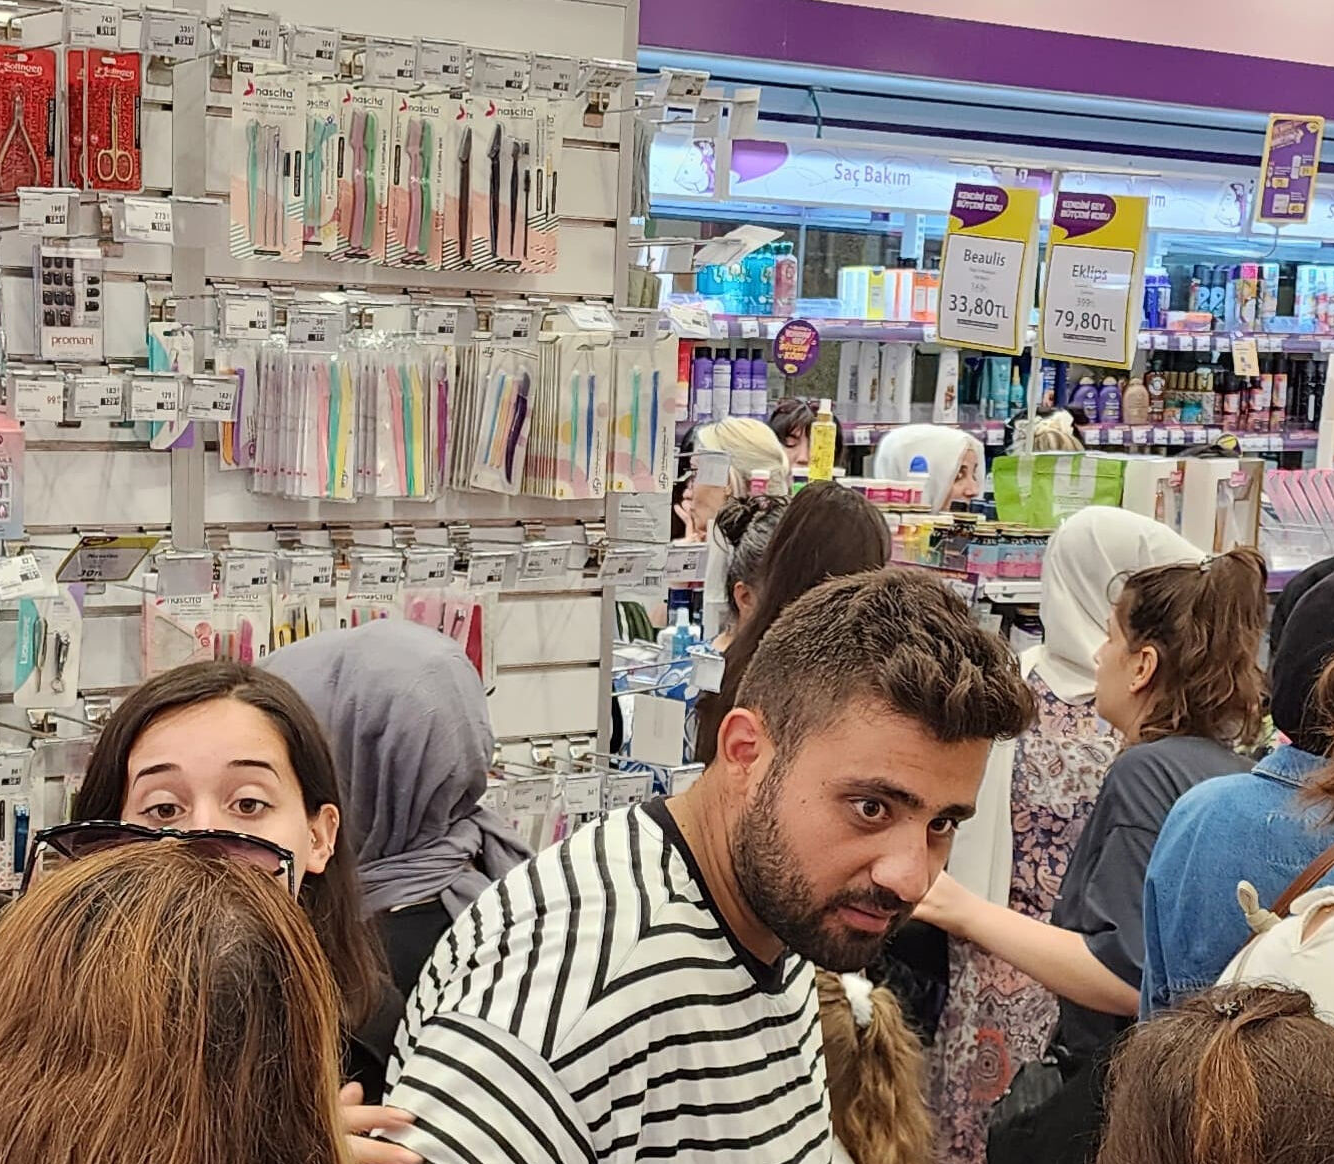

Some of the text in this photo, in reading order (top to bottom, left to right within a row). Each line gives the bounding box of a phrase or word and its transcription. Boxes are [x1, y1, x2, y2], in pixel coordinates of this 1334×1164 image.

[255, 86, 294, 99] nascita
[351, 95, 384, 106] nascita
[407, 103, 440, 114] nascita
[497, 106, 536, 117] nascita
[834, 163, 911, 188] Saç Bakım
[964, 249, 1006, 266] Beaulis
[1072, 264, 1108, 282] Eklips
[949, 294, 1008, 319] 33,80TL
[1054, 309, 1116, 332] 79,80TL
[51, 335, 94, 347] promani
